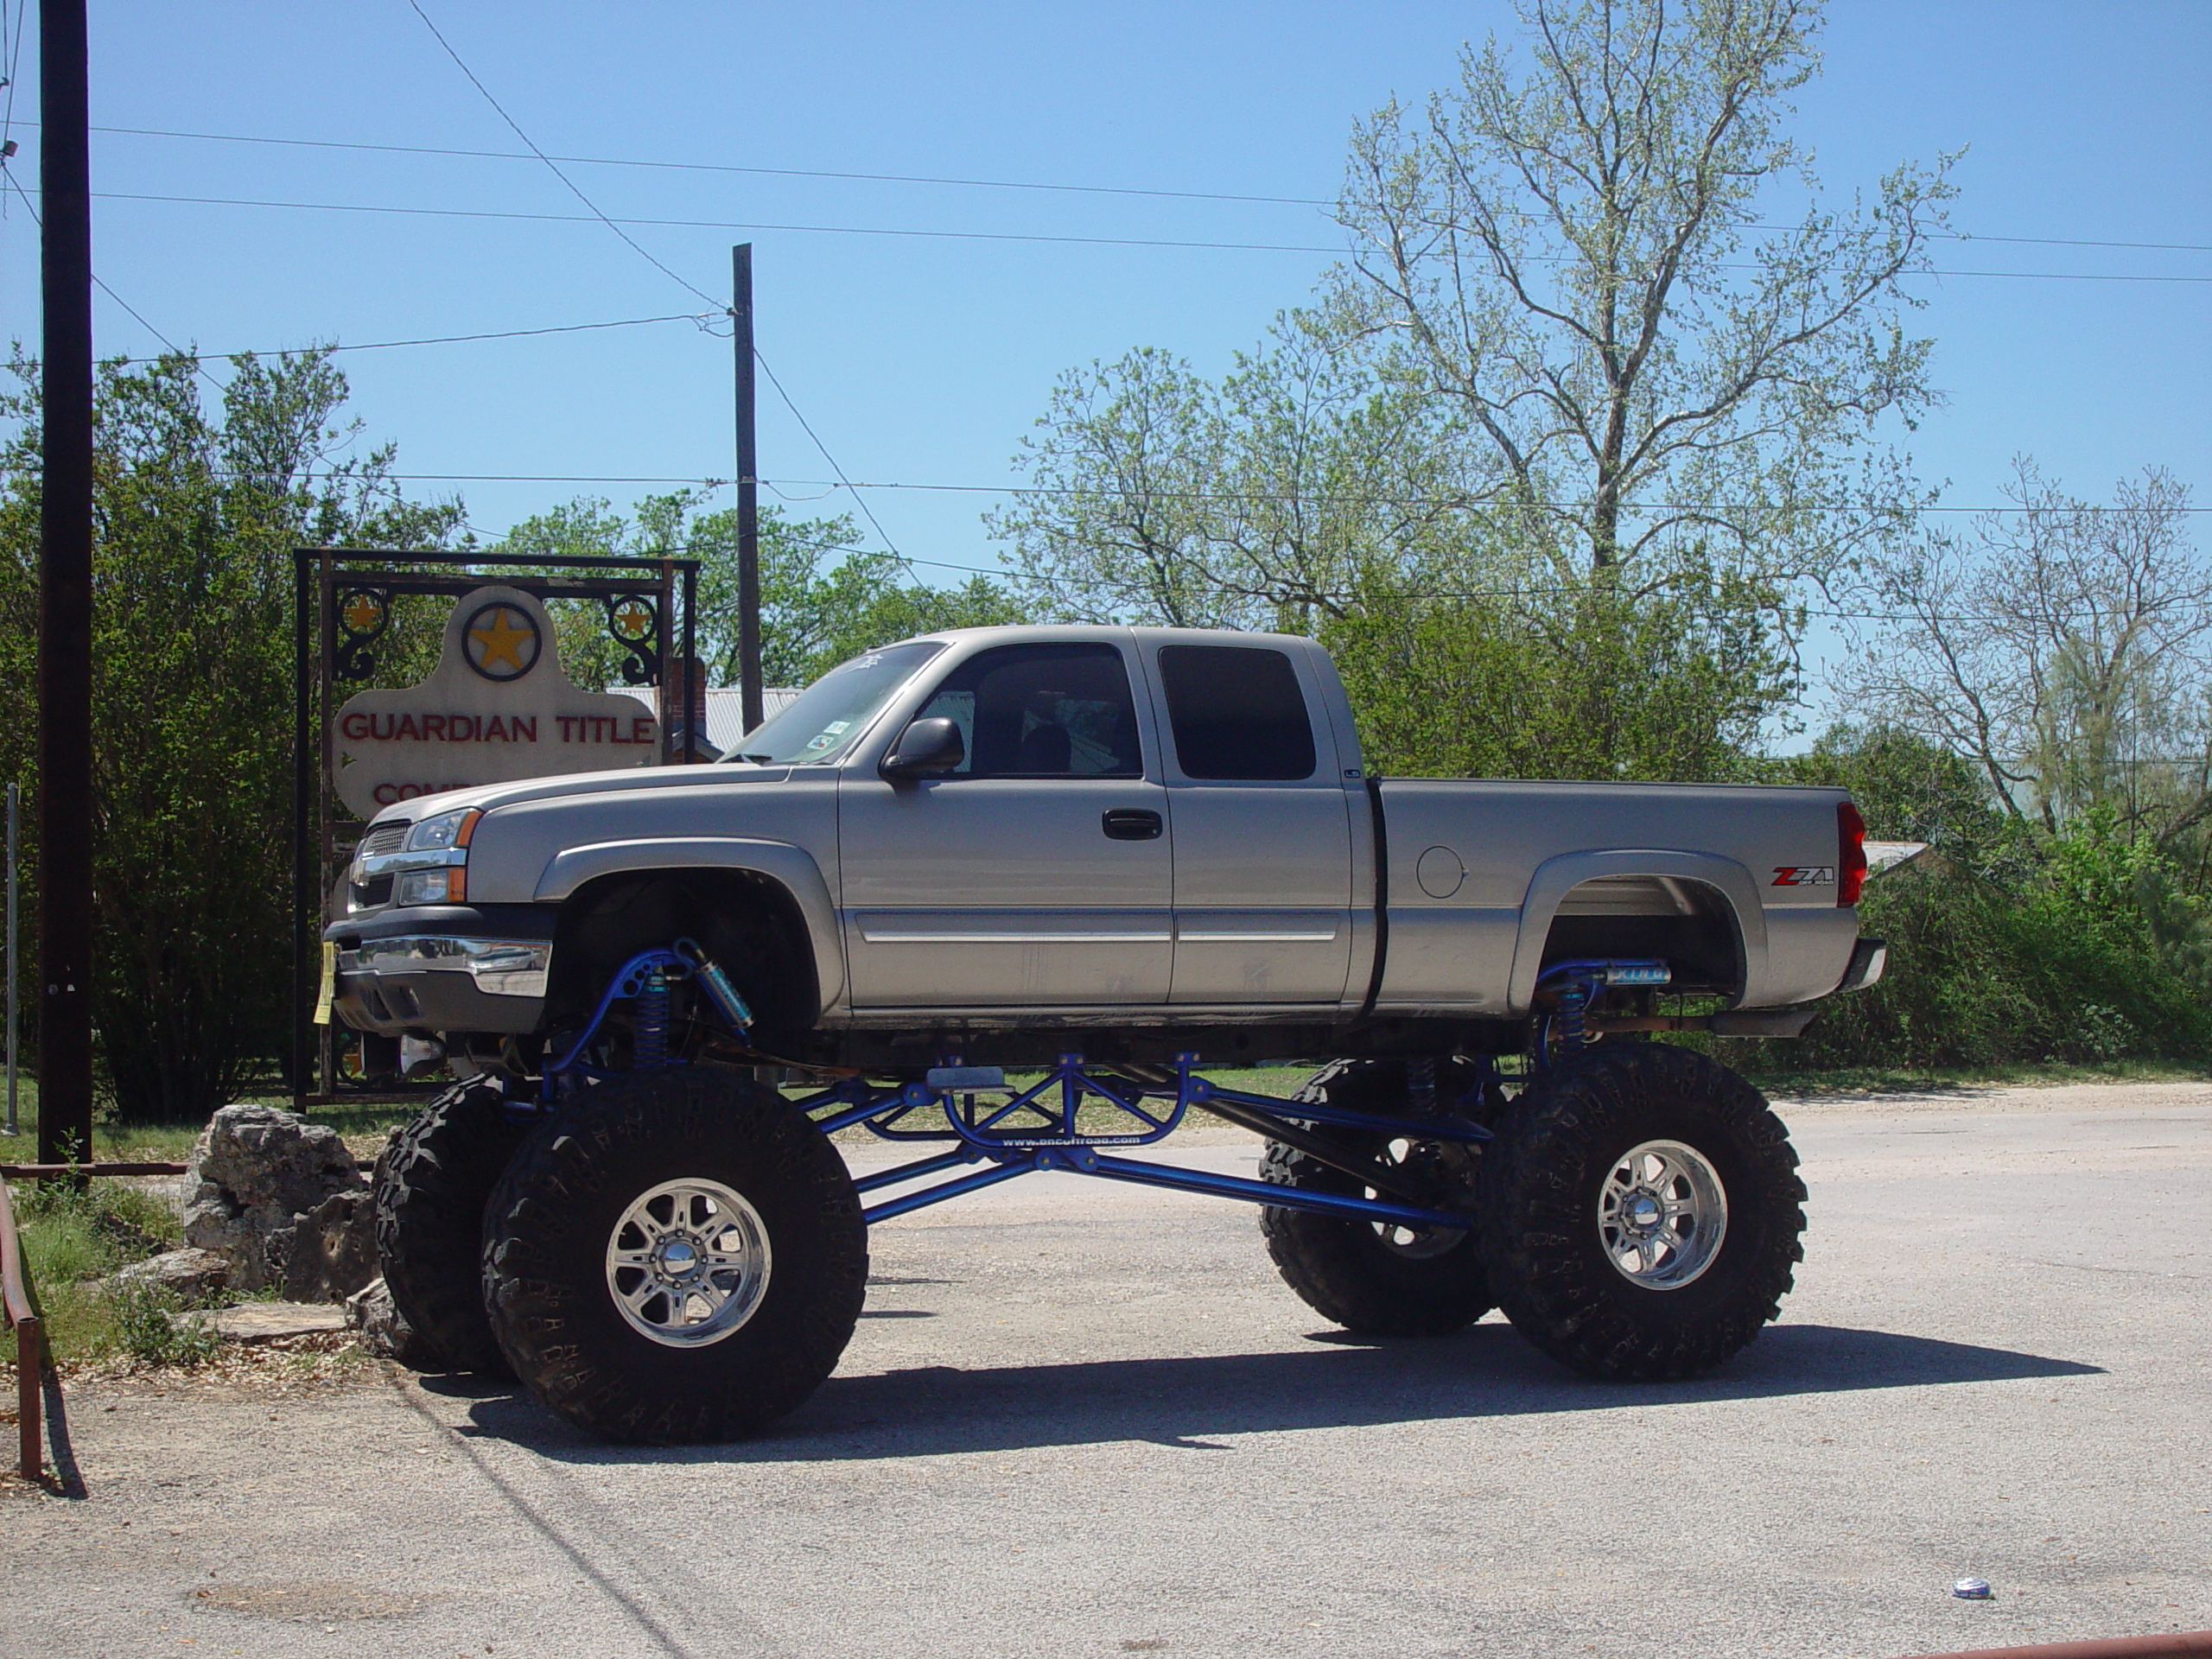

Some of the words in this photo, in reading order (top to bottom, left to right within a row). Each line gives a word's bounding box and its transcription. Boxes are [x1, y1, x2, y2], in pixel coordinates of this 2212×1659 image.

[341, 713, 537, 743] GUARDIAN
[556, 715, 655, 745] TITLE
[1771, 866, 1834, 886] Z71
